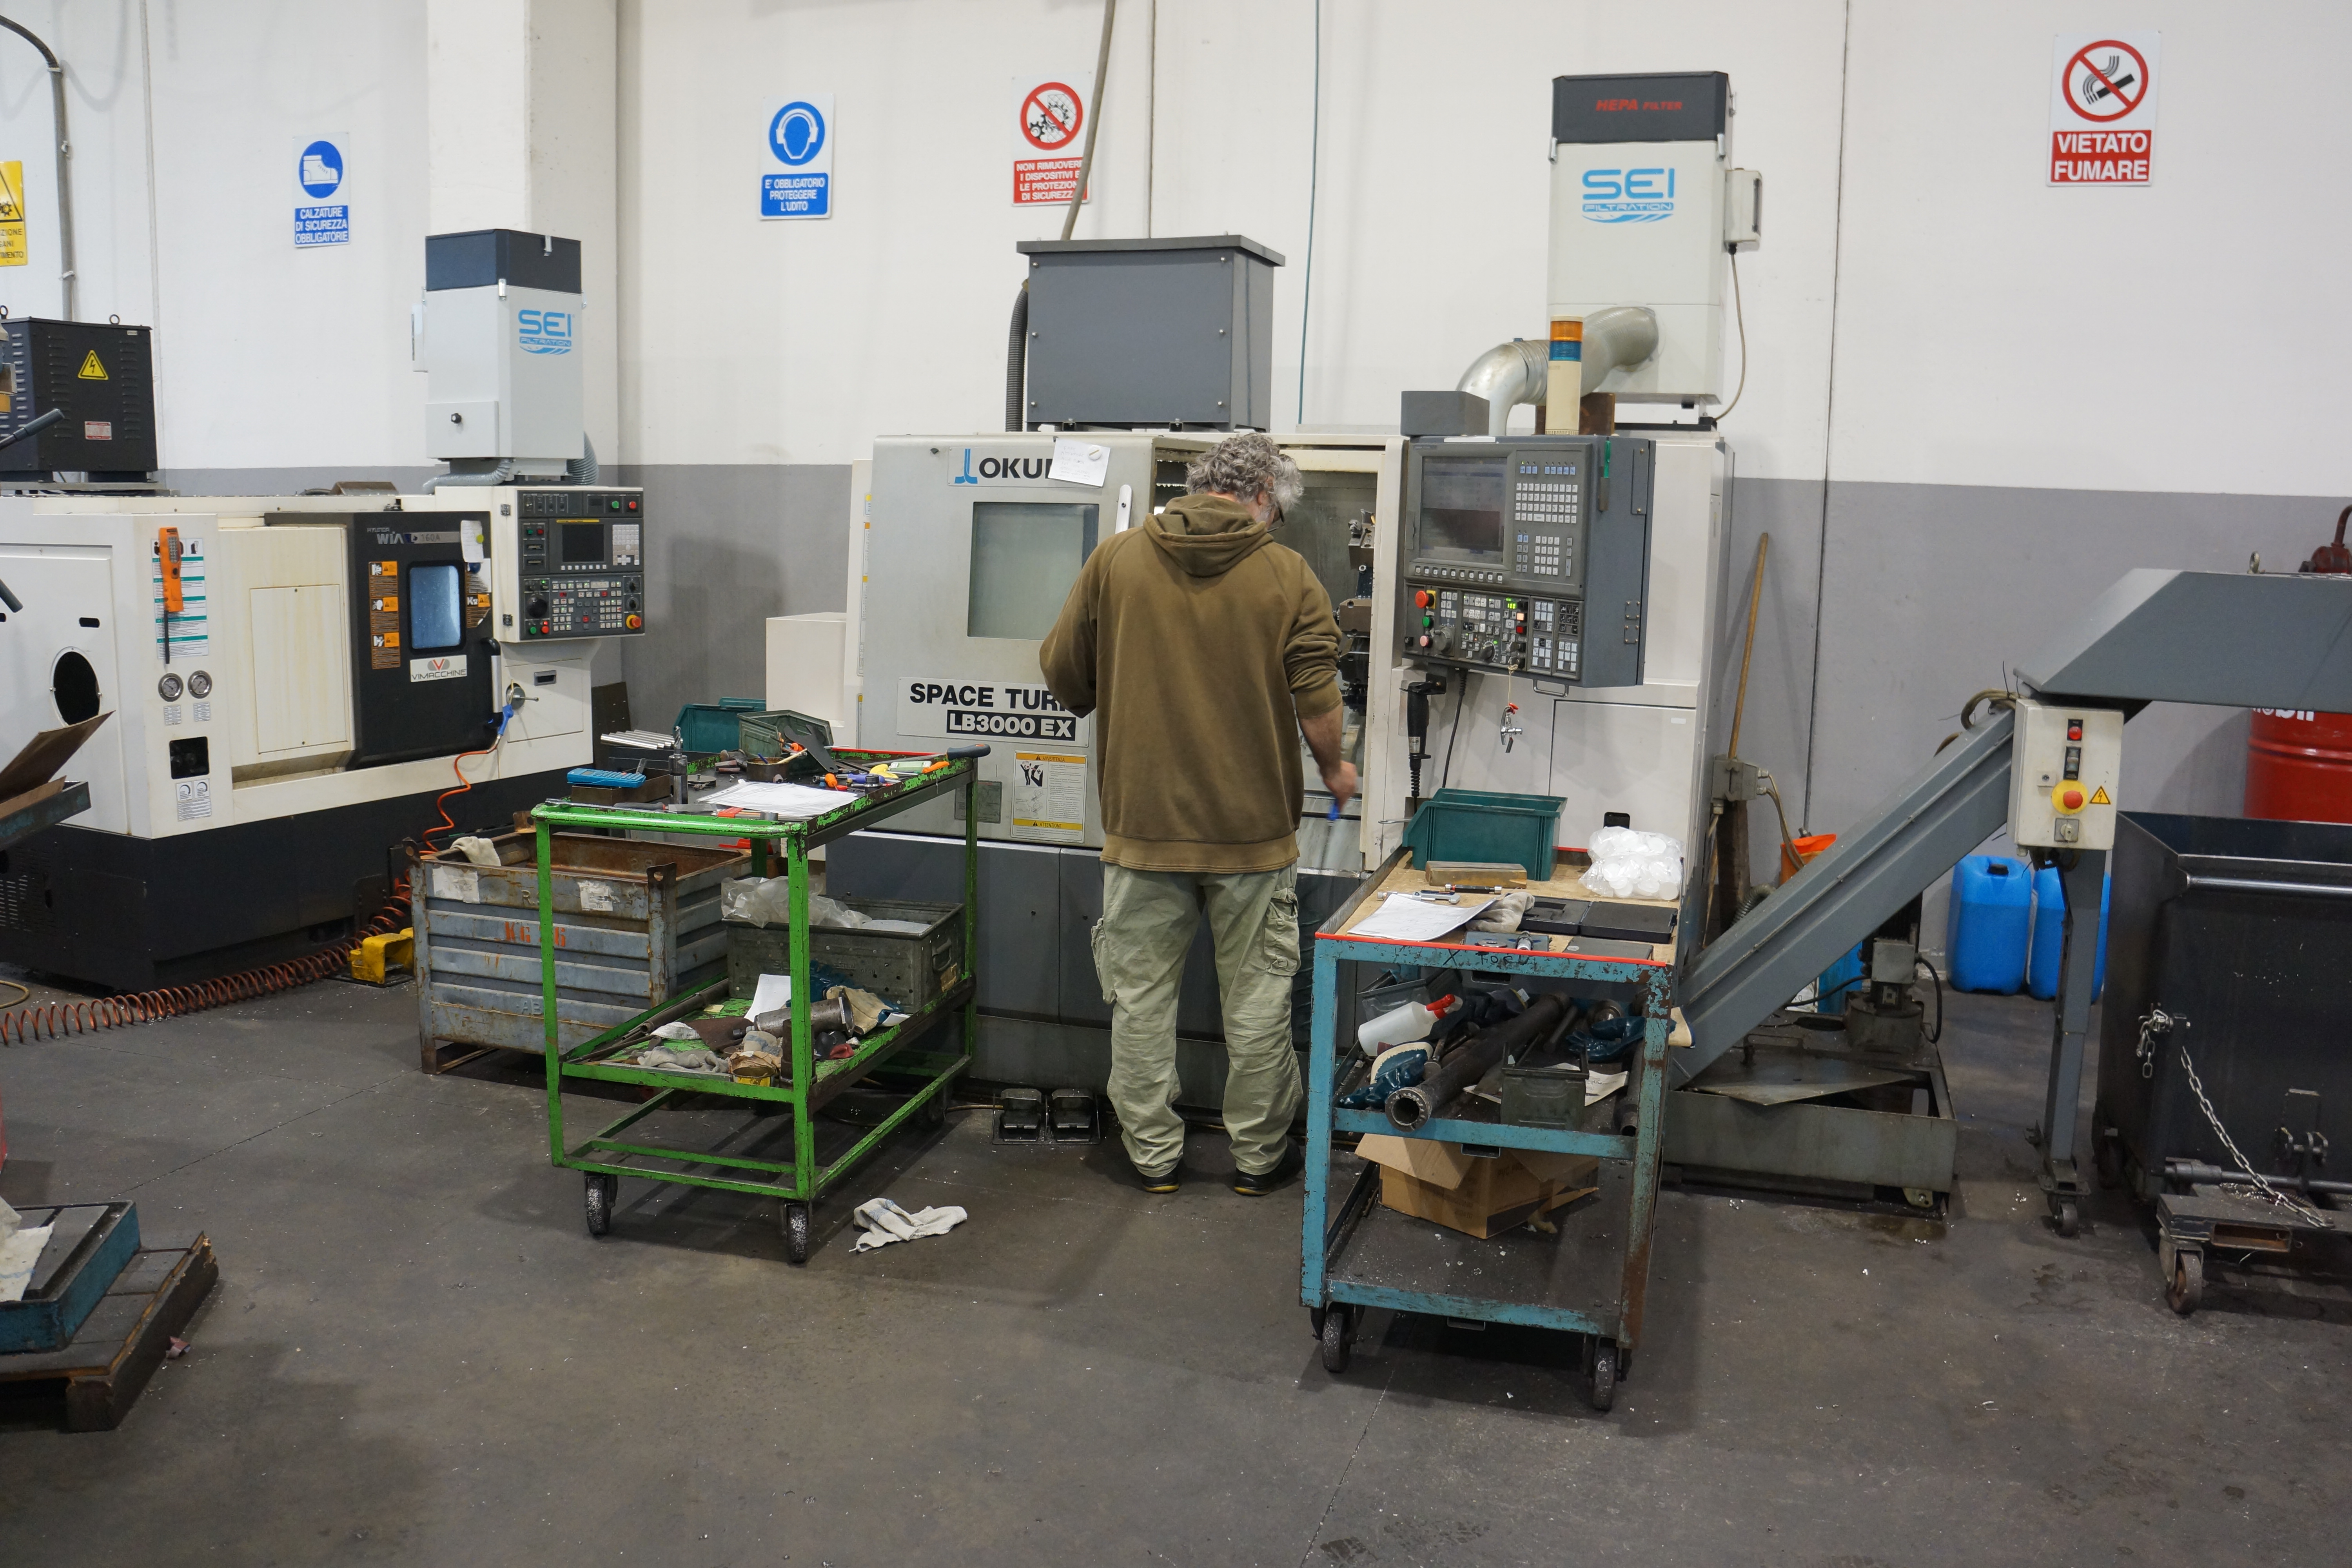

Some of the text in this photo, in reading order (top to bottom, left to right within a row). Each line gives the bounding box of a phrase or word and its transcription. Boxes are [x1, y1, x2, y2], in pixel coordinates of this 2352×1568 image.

[1596, 99, 1682, 111] HEPA FILTER
[2057, 132, 2147, 153] VIETATO
[1016, 163, 1035, 171] NON
[2054, 160, 2148, 180] FUMARE
[1025, 171, 1073, 181] DISPOSITIVI
[774, 178, 825, 189] OBBLIGATORIO
[1020, 183, 1030, 191] LE
[1582, 168, 1675, 200] SEI
[770, 189, 817, 200] PROTEGGERE
[1032, 191, 1073, 200] SICUREZZ
[780, 201, 808, 211] L'UDITO
[1584, 203, 1673, 212] FILTRATION
[300, 207, 343, 219] CALZATURE
[296, 219, 347, 231] DI SICUREZZA
[296, 231, 348, 243] OBBLIGATORIE
[518, 309, 571, 338] SEI
[521, 338, 571, 347] FILTRATION
[412, 669, 467, 680] VIMACCHINE
[910, 683, 1066, 712] SPACE TUR
[949, 713, 1072, 738] LB3000 EX
[505, 921, 531, 943] KG
